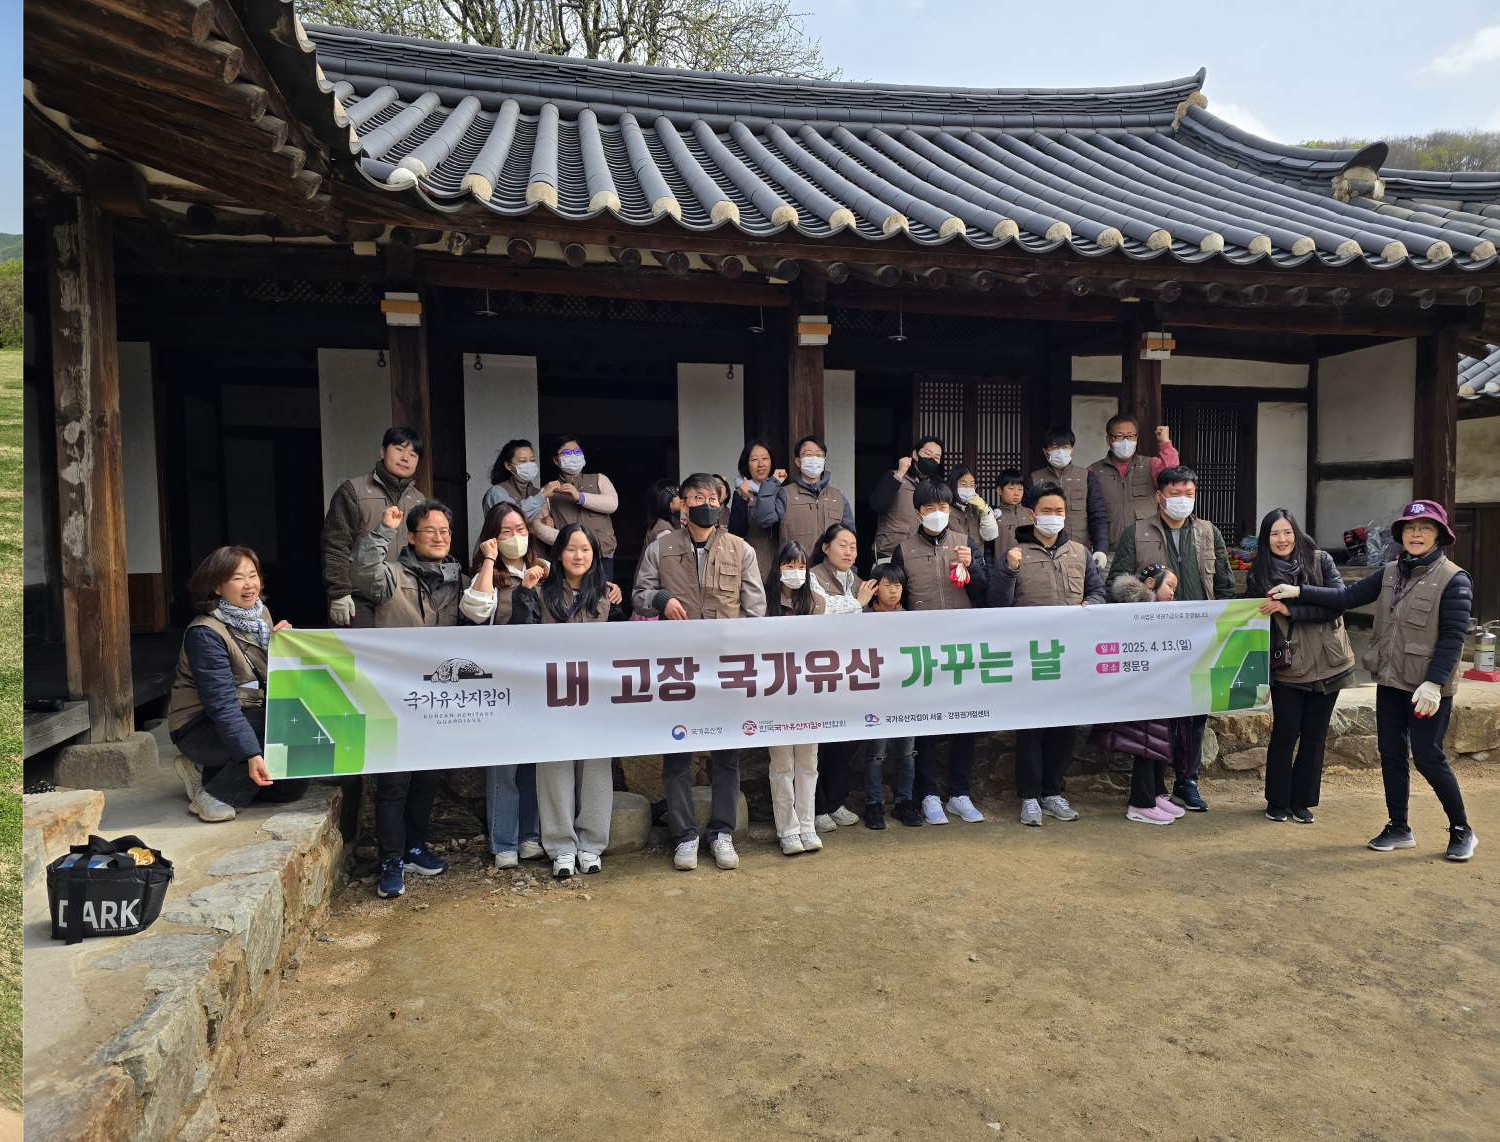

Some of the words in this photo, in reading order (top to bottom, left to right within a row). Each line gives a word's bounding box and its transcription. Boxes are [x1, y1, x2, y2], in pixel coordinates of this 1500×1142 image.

[1122, 642, 1148, 653] 2025.
[1150, 641, 1159, 652] 4.
[1161, 639, 1192, 651] 13.(일)
[1122, 660, 1150, 672] 청문당
[546, 661, 588, 707] 내
[611, 656, 700, 704] 고장
[717, 648, 884, 698] 국가유산
[899, 642, 1014, 688] 가꾸는
[1030, 639, 1065, 681] 날
[403, 687, 510, 710] 국가유산지킴이
[885, 713, 929, 723] 국가유산지킴이
[930, 712, 942, 721] 서울
[947, 710, 990, 720] 강원권거점센터
[690, 726, 723, 735] 국가유산청
